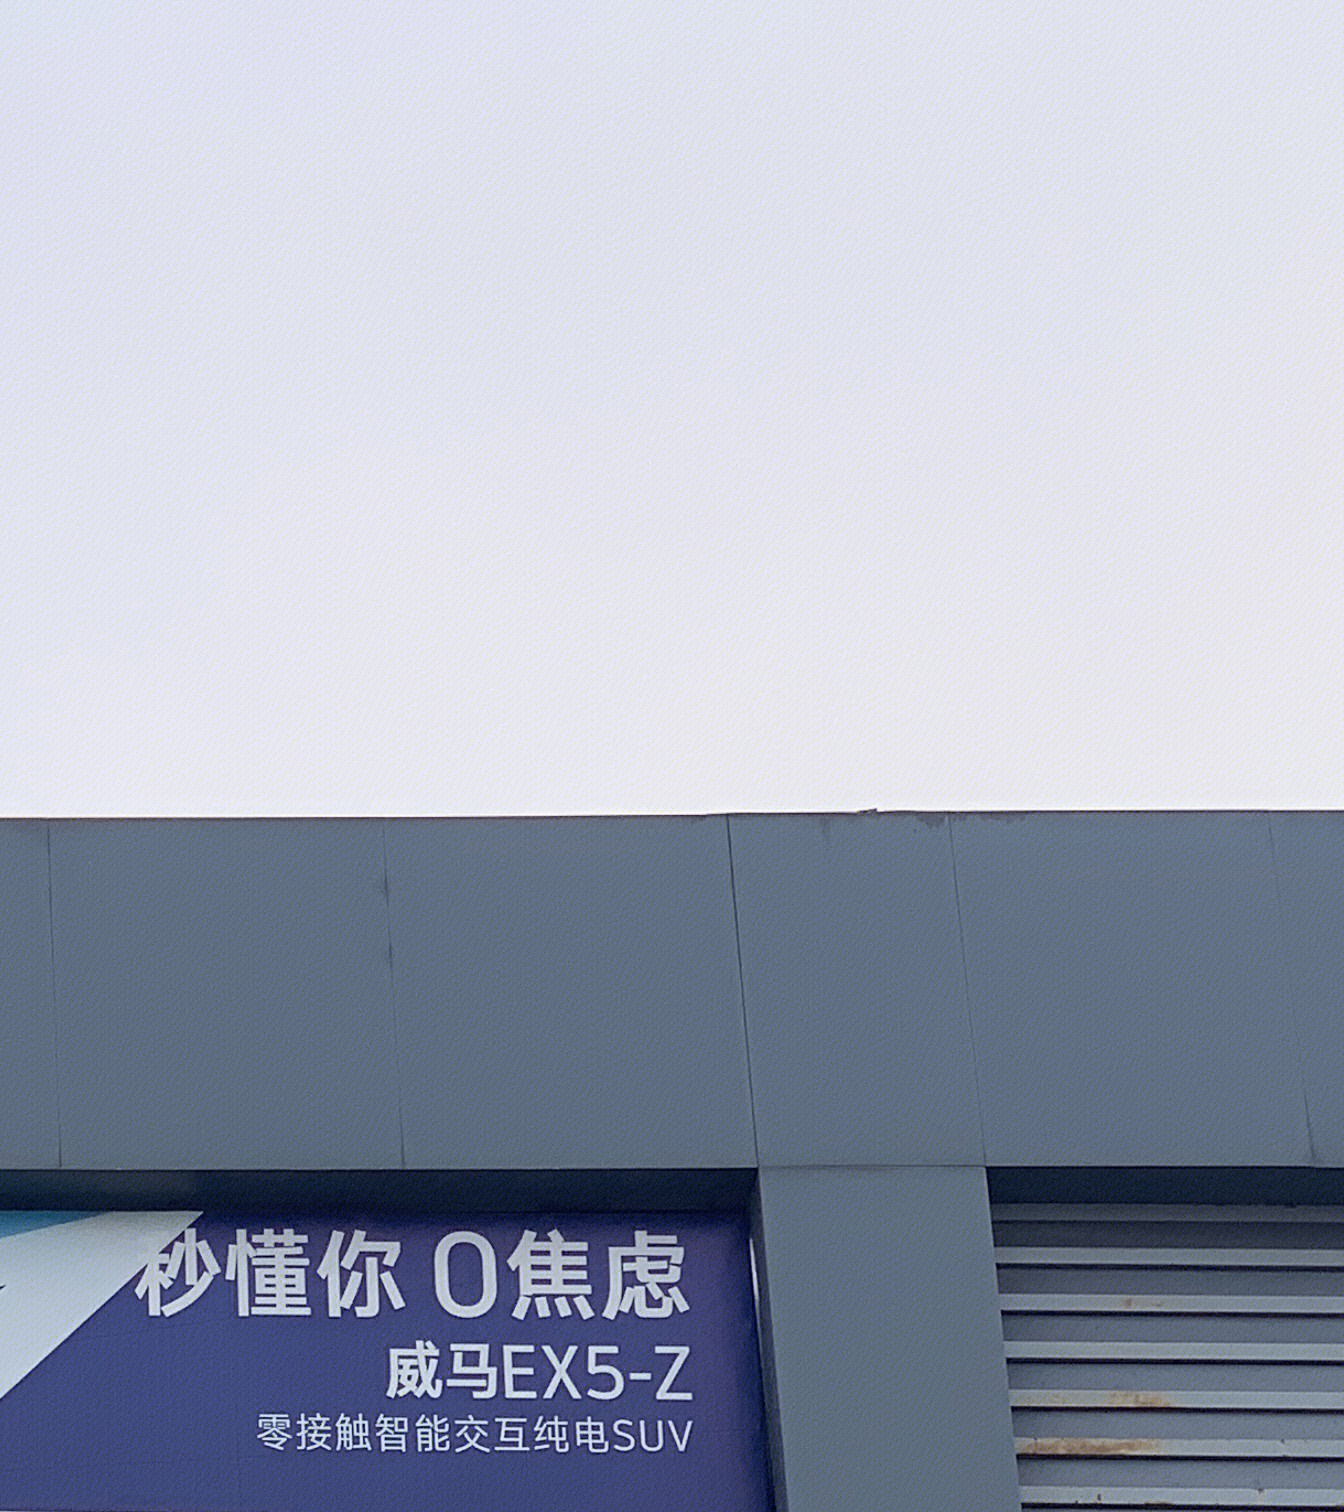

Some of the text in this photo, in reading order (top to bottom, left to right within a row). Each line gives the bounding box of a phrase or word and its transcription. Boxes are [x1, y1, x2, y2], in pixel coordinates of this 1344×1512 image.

[134, 1227, 405, 1318] 秒懂你
[385, 1339, 693, 1401] 威马EX5-Z
[256, 1412, 693, 1453] 零接触智能交互纯电SUV
